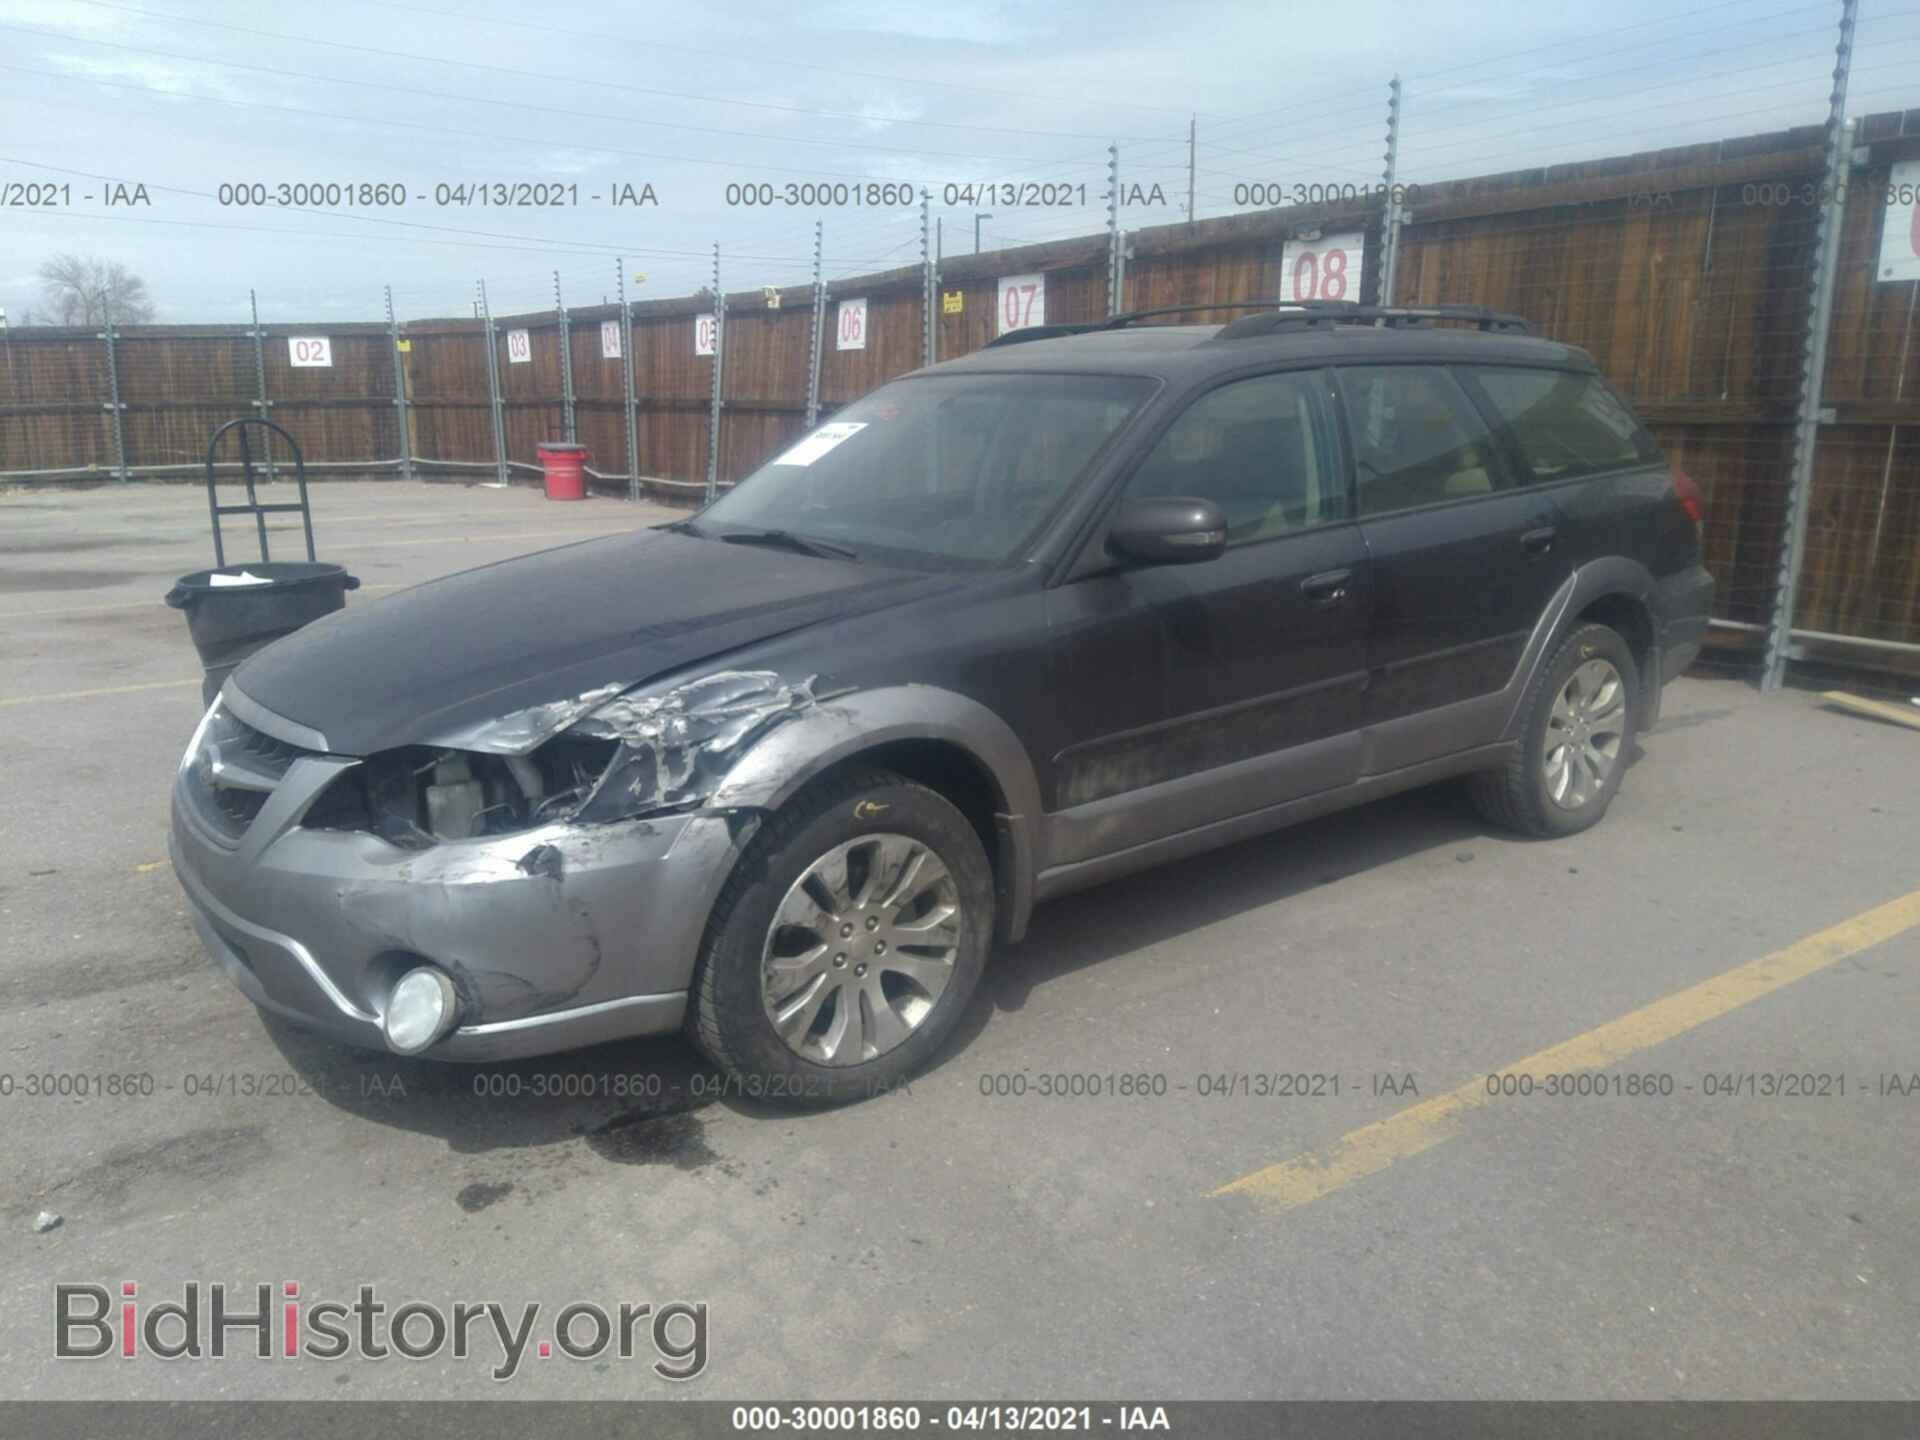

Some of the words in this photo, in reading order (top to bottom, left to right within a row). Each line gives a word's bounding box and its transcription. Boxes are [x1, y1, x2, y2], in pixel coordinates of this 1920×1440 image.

[1293, 249, 1347, 302] 08
[1005, 284, 1036, 328] 07
[842, 307, 861, 341] 06
[296, 340, 325, 362] 02
[511, 330, 528, 358] 03
